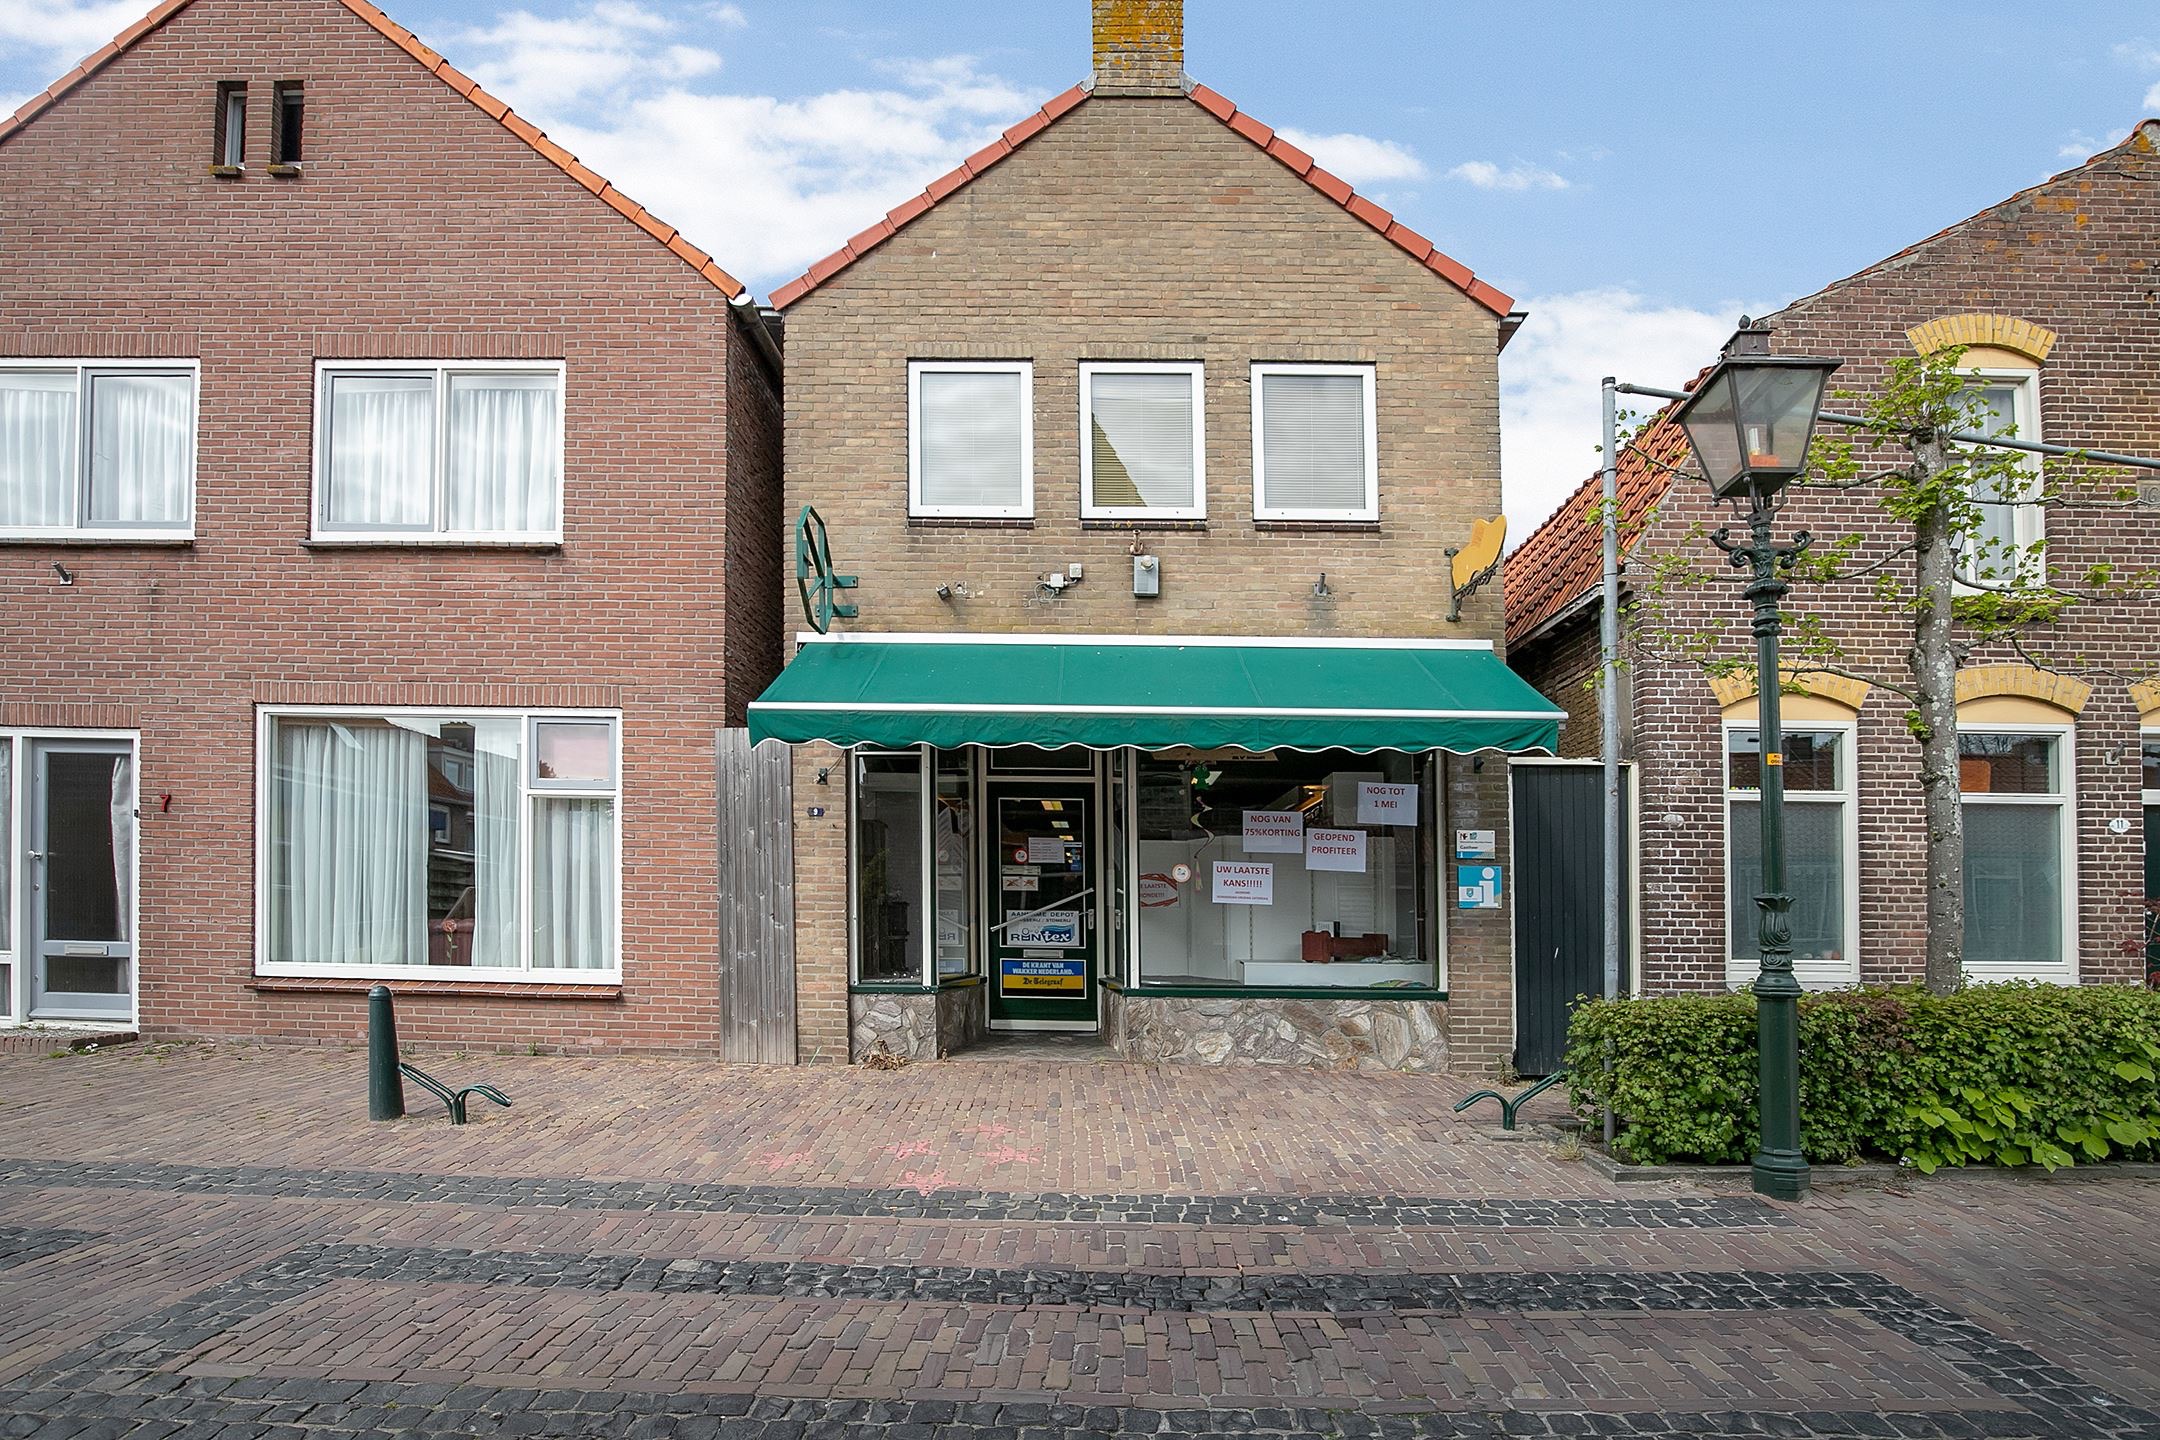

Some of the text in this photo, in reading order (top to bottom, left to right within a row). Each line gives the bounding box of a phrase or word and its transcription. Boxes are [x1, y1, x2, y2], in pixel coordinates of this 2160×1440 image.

[1366, 786, 1405, 796] NOG TOT
[159, 793, 172, 813] 7
[1374, 800, 1398, 808] 1 MEI
[1250, 815, 1291, 823] NOG VAN
[2116, 819, 2124, 829] 11
[1244, 828, 1301, 837] 75%KORTING
[1313, 833, 1355, 842] GEOPEND
[1311, 846, 1357, 855] PROFITEER
[1216, 865, 1270, 875] UW LAATSTE
[1223, 879, 1263, 888] KANS!!!!!
[1022, 977, 1033, 985] De
